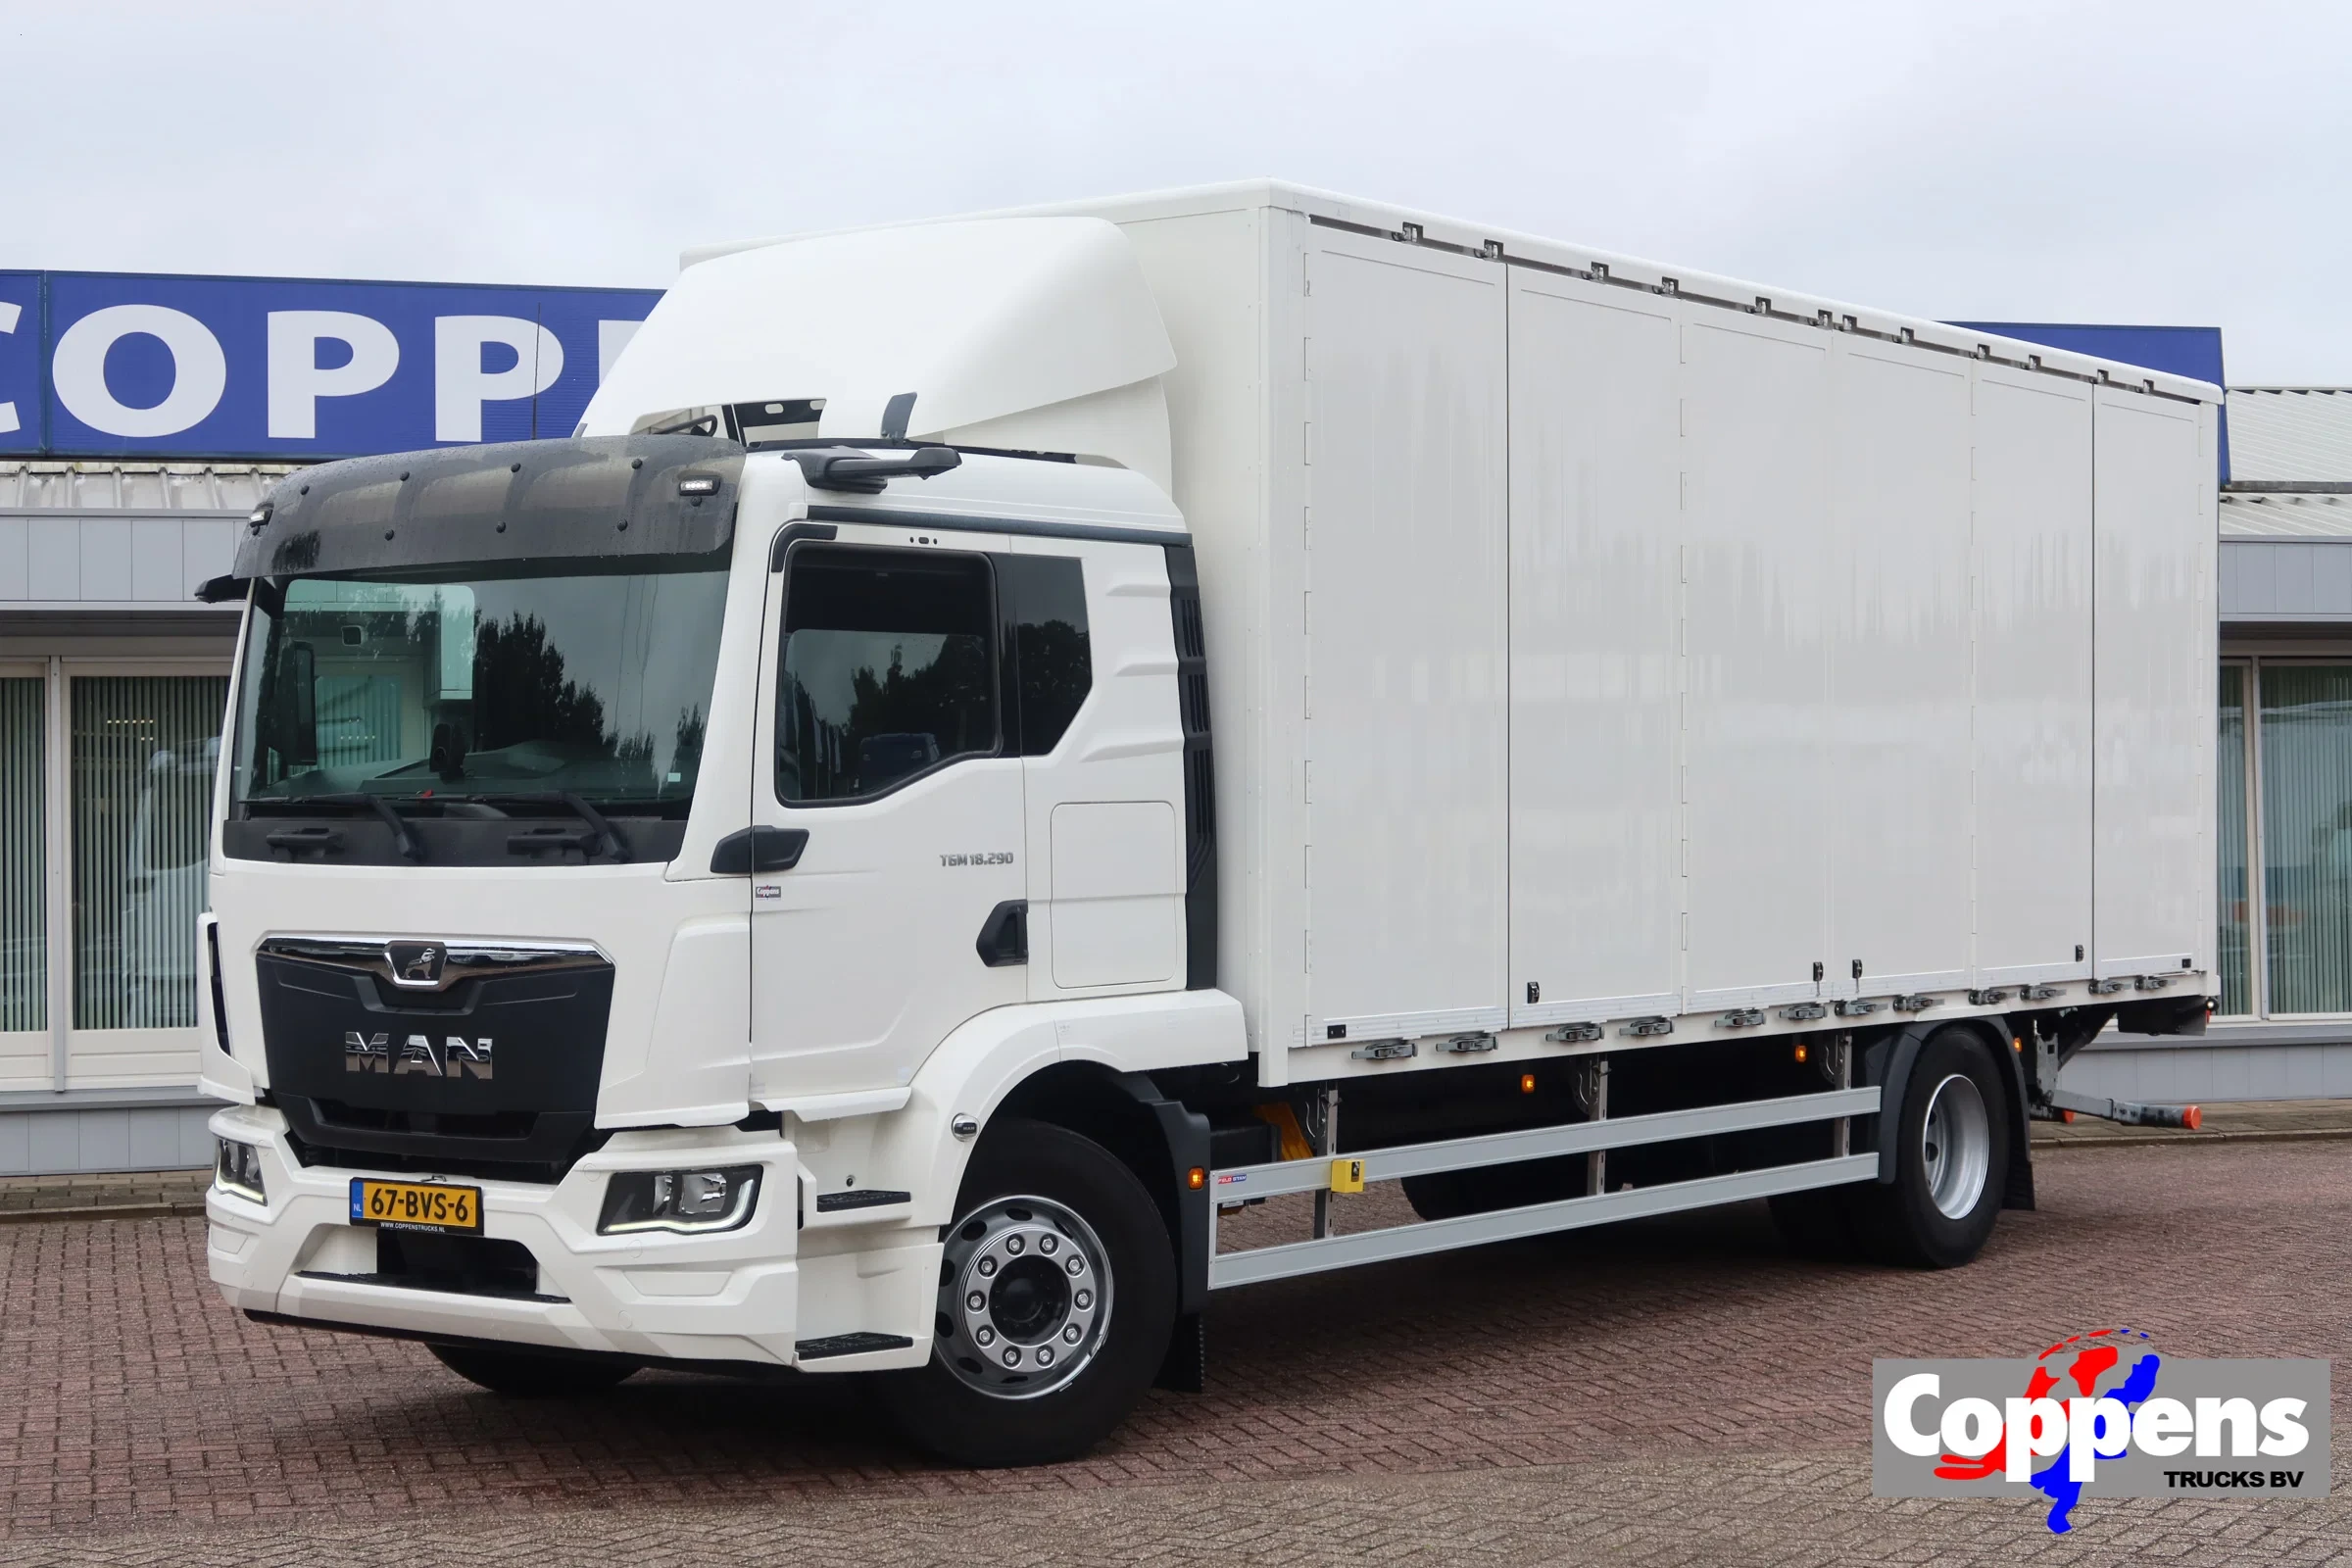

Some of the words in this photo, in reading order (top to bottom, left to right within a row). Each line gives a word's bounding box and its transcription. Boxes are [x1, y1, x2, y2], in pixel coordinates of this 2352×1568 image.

[0, 301, 646, 442] OPP
[940, 853, 967, 867] TGM
[969, 852, 1014, 866] 18.290
[345, 1031, 493, 1080] MAN
[353, 1203, 362, 1212] NL
[370, 1188, 468, 1223] 67-BVS-6
